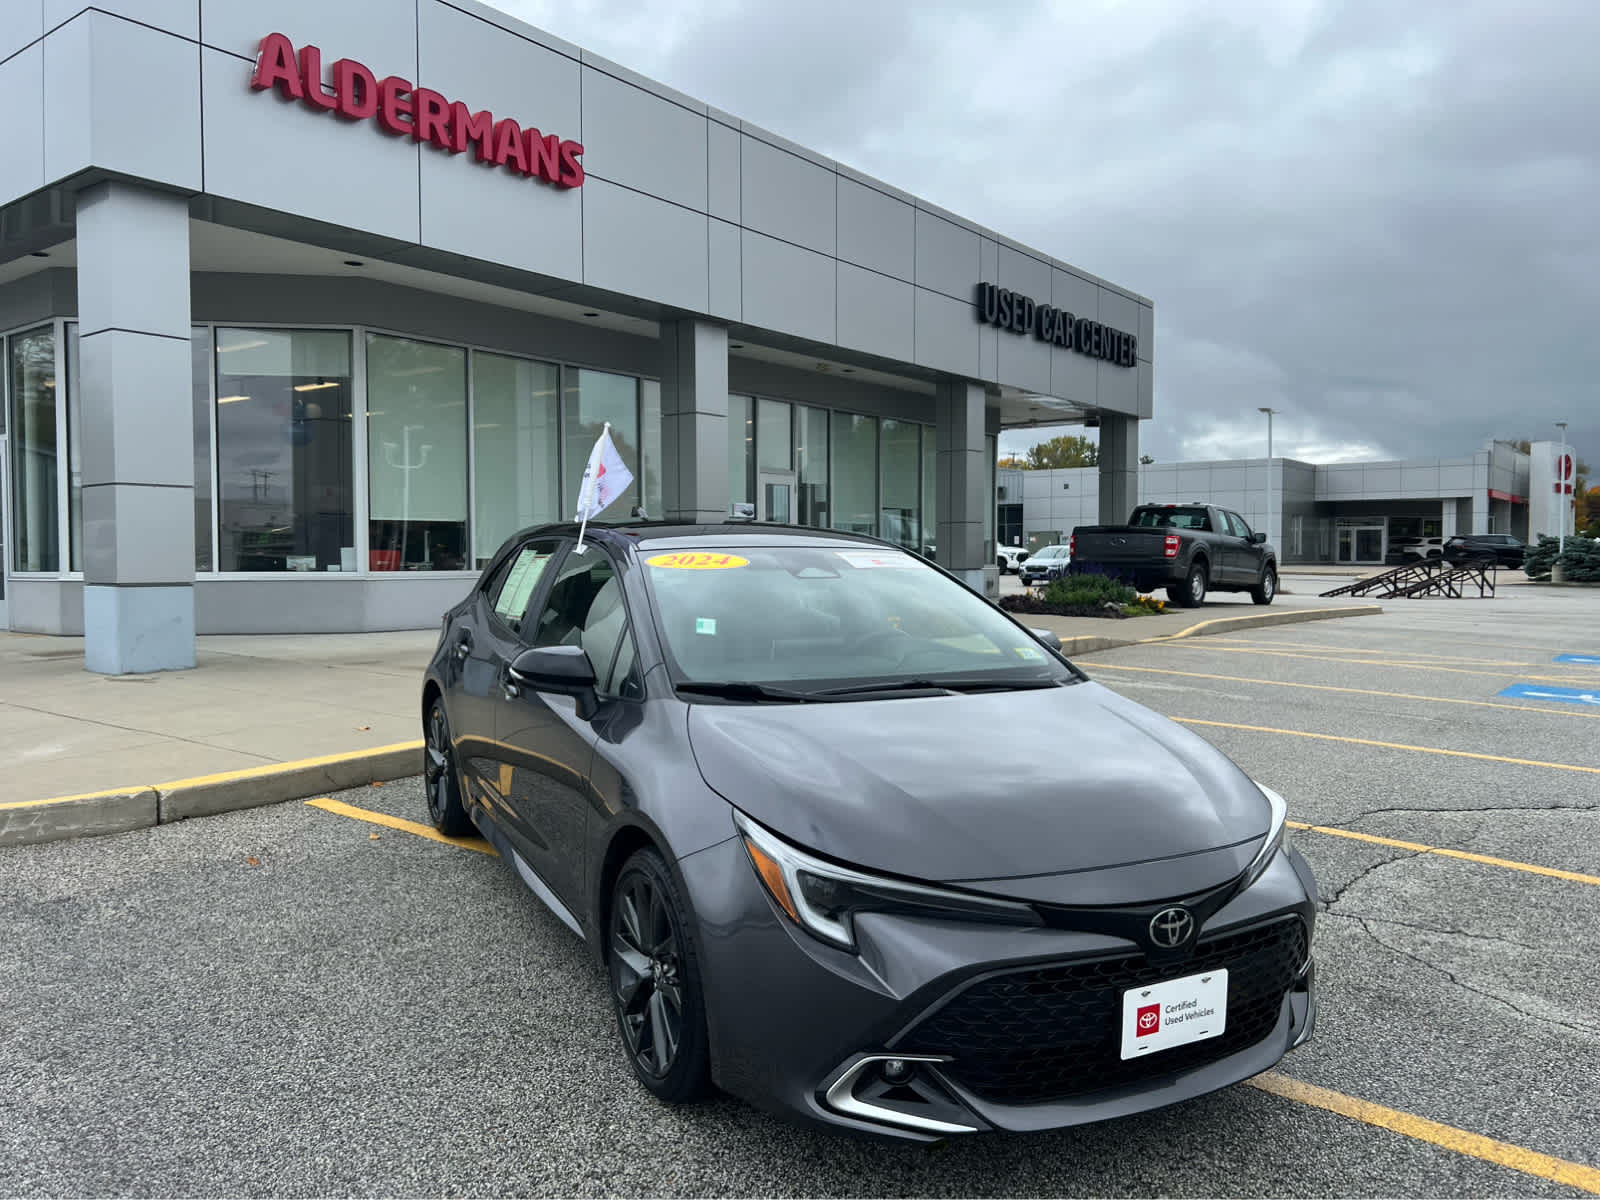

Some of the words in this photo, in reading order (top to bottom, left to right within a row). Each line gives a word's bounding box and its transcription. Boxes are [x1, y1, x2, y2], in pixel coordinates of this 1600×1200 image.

[251, 32, 585, 188] ALDERMANS
[977, 282, 1035, 334] USED
[1035, 304, 1076, 350] CAR
[1074, 318, 1138, 368] CENTER
[660, 555, 730, 566] 2024
[1165, 998, 1197, 1013] Certified
[1165, 1014, 1184, 1026] Used
[1184, 1008, 1214, 1020] Vehicles
